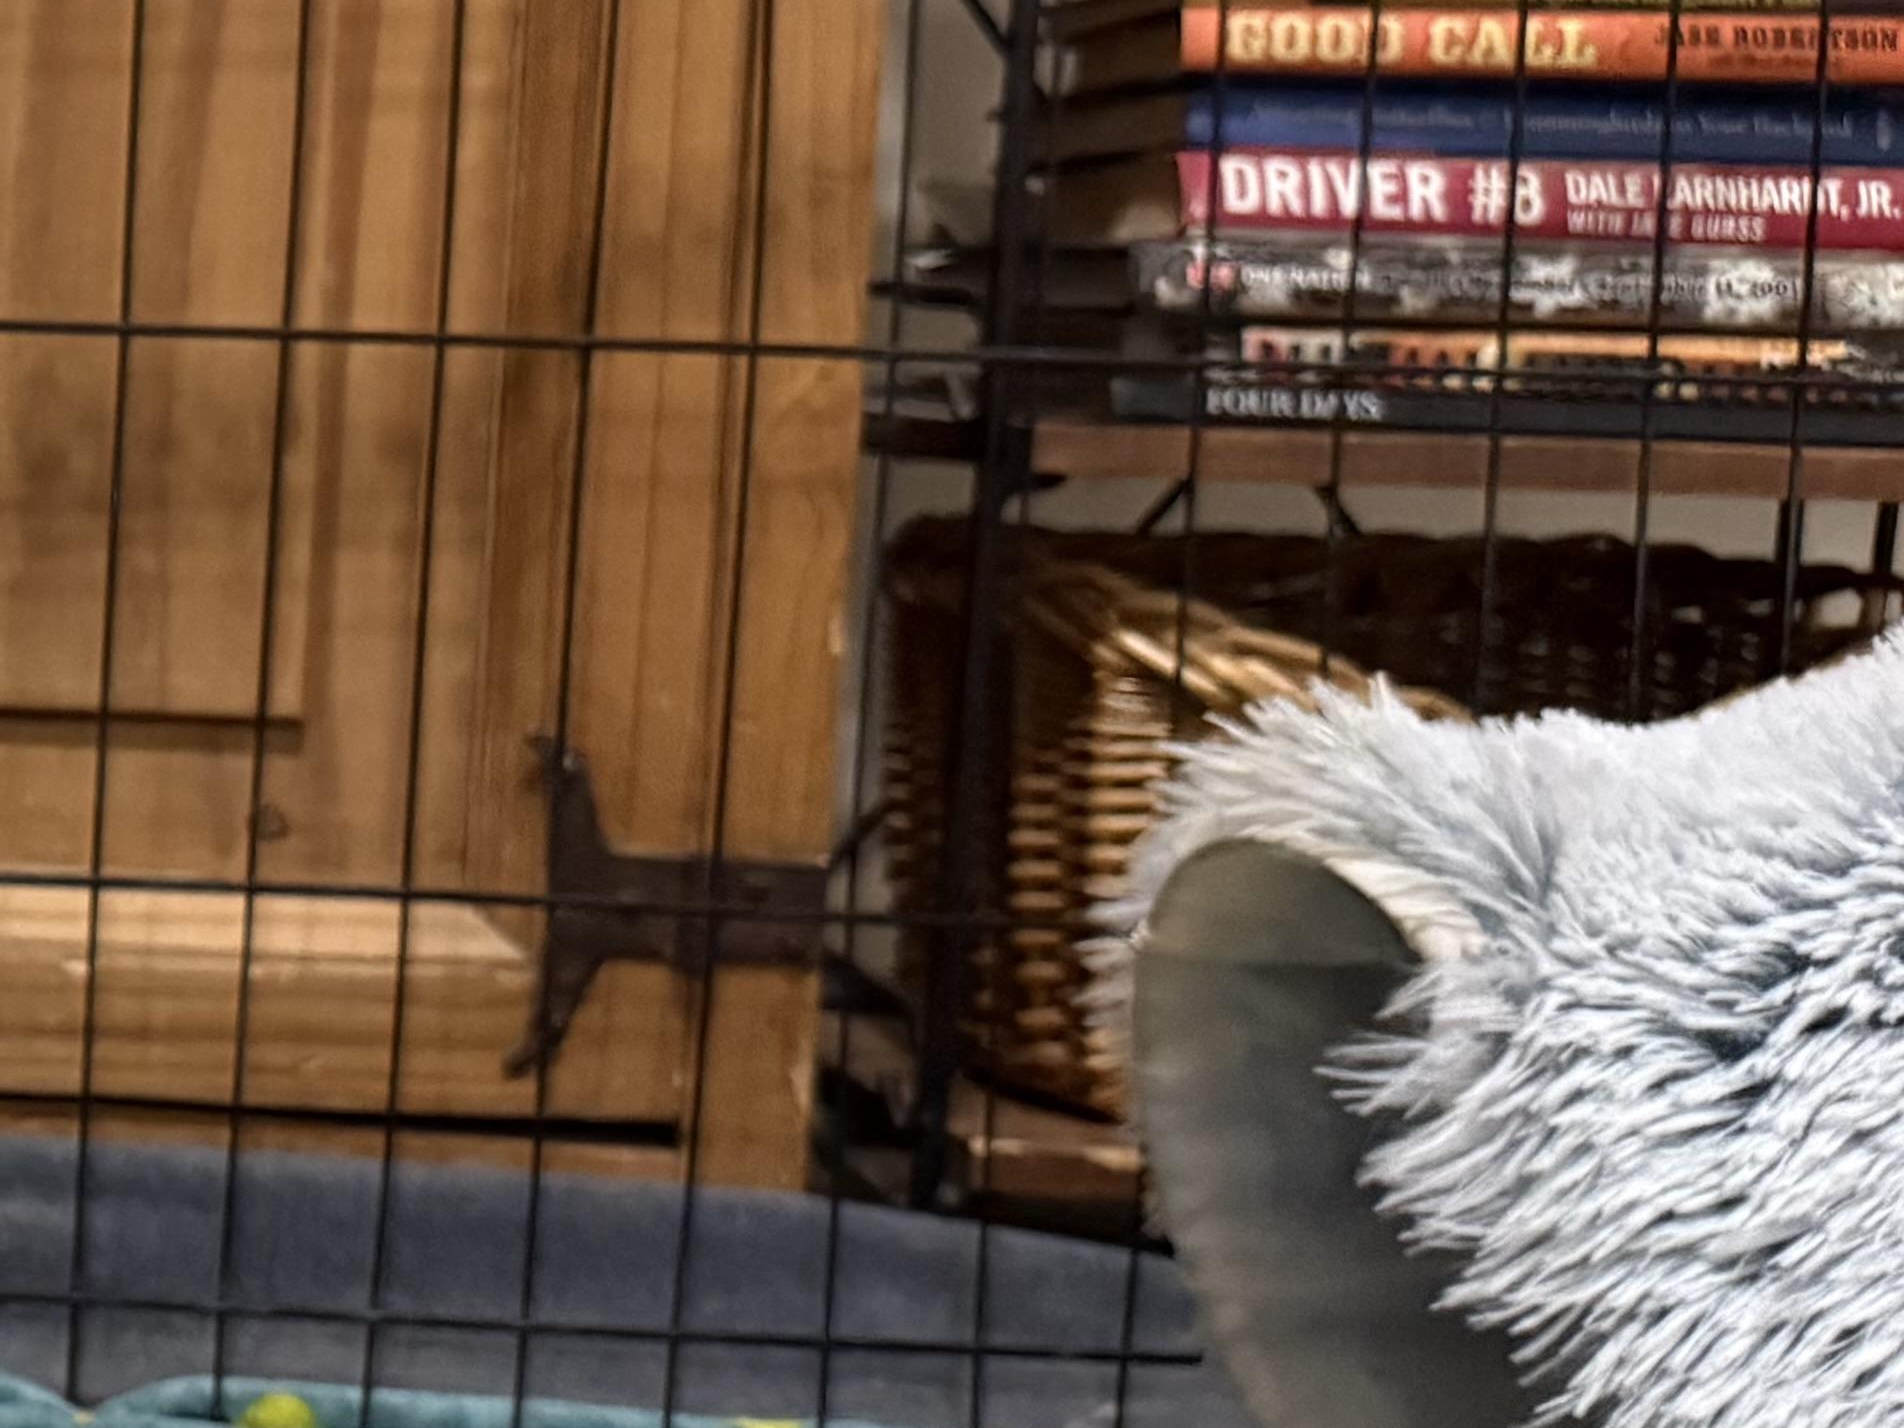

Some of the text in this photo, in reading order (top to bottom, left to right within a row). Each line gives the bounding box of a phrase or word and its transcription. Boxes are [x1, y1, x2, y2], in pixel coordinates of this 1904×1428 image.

[1225, 10, 1598, 69] GOOD CALL
[1219, 155, 1546, 229] DRIVER #8
[1564, 171, 1901, 222] DALE ARNHARDT, JR.
[1566, 209, 1621, 235] WITH
[1630, 212, 1680, 239] JAE
